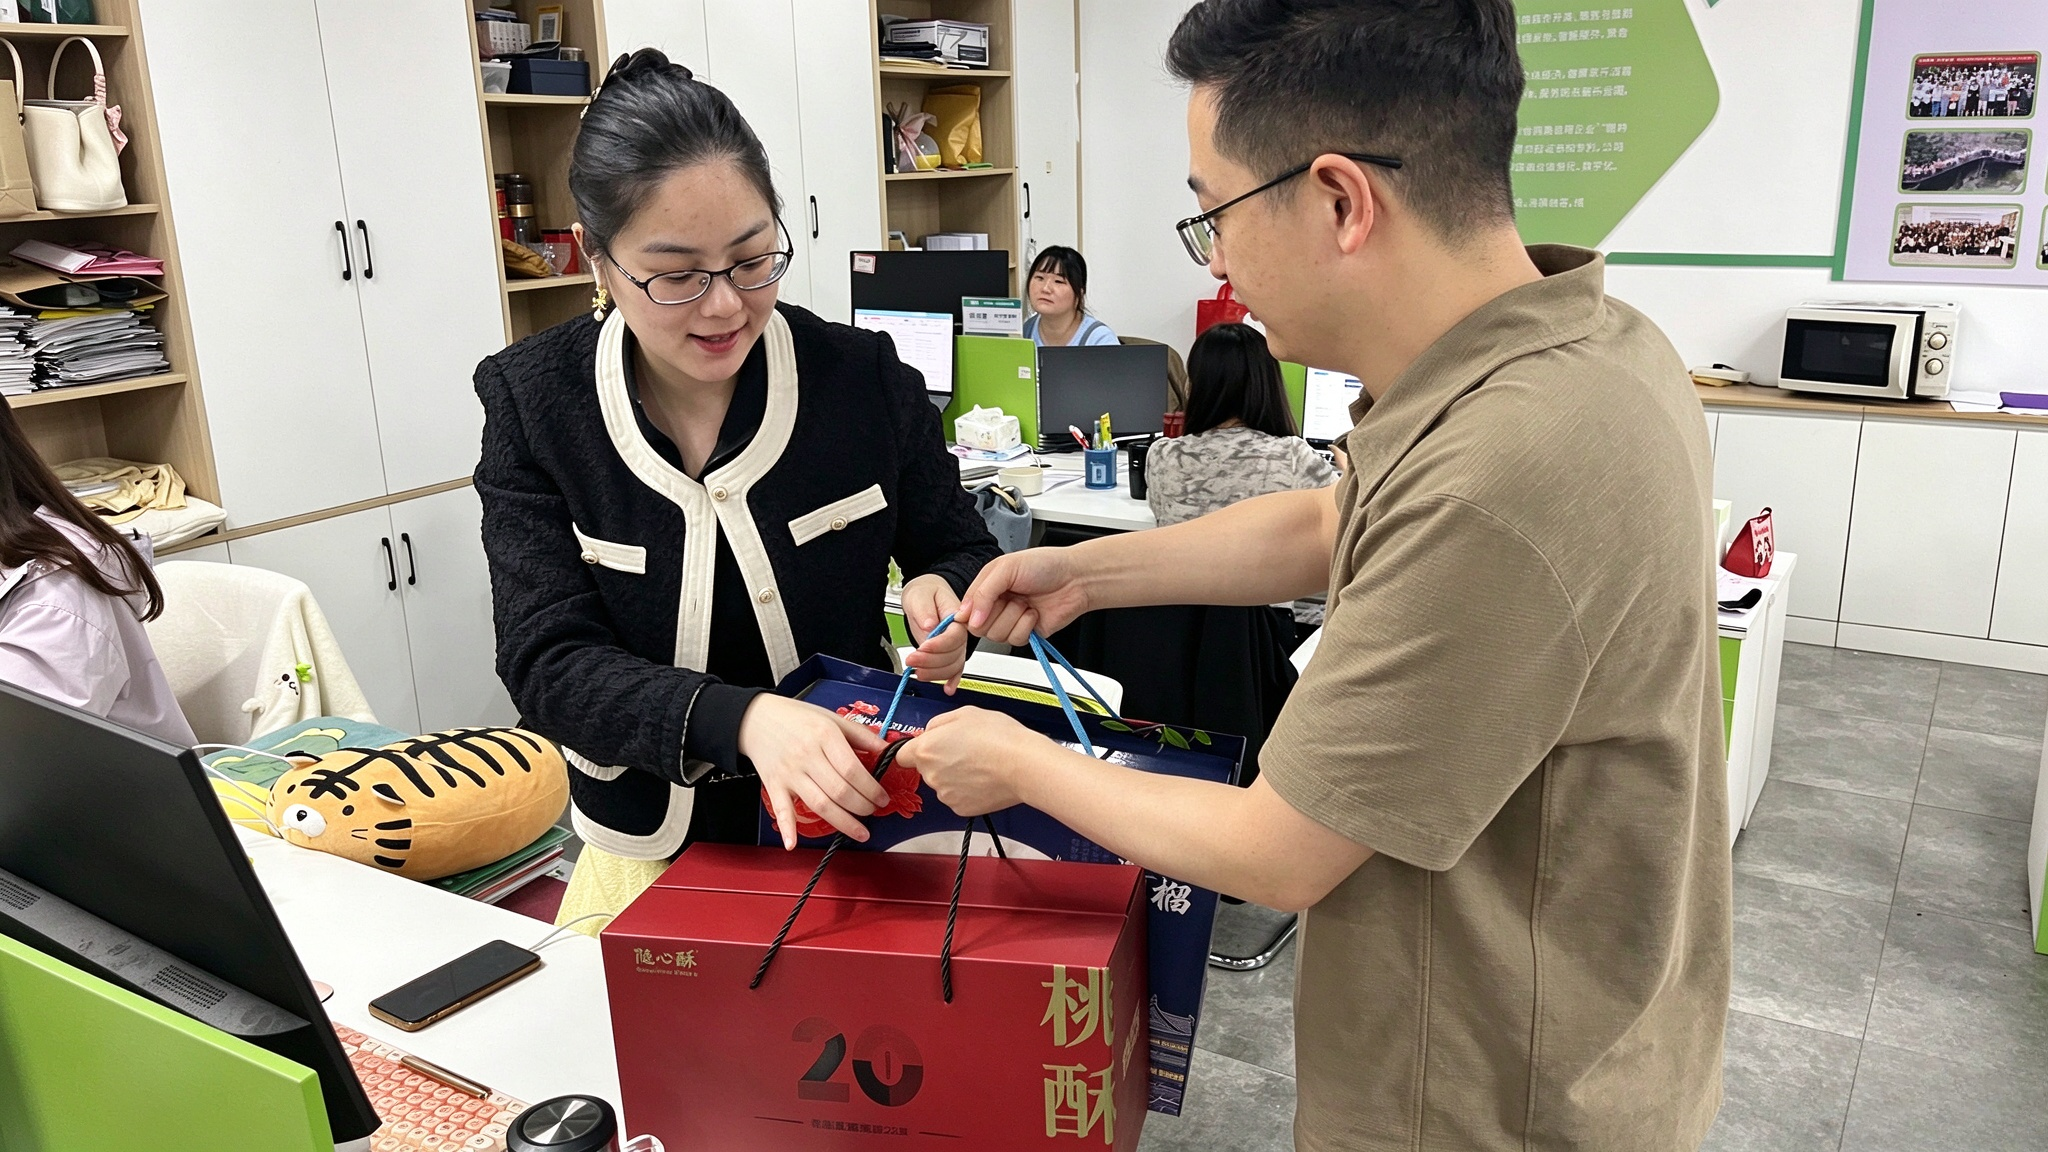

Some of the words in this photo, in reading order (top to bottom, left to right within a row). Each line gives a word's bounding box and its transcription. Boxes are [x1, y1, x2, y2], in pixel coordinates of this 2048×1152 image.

[1151, 877, 1191, 915] 榴
[792, 1016, 924, 1107] 20
[1040, 964, 1116, 1146] 桃酥
